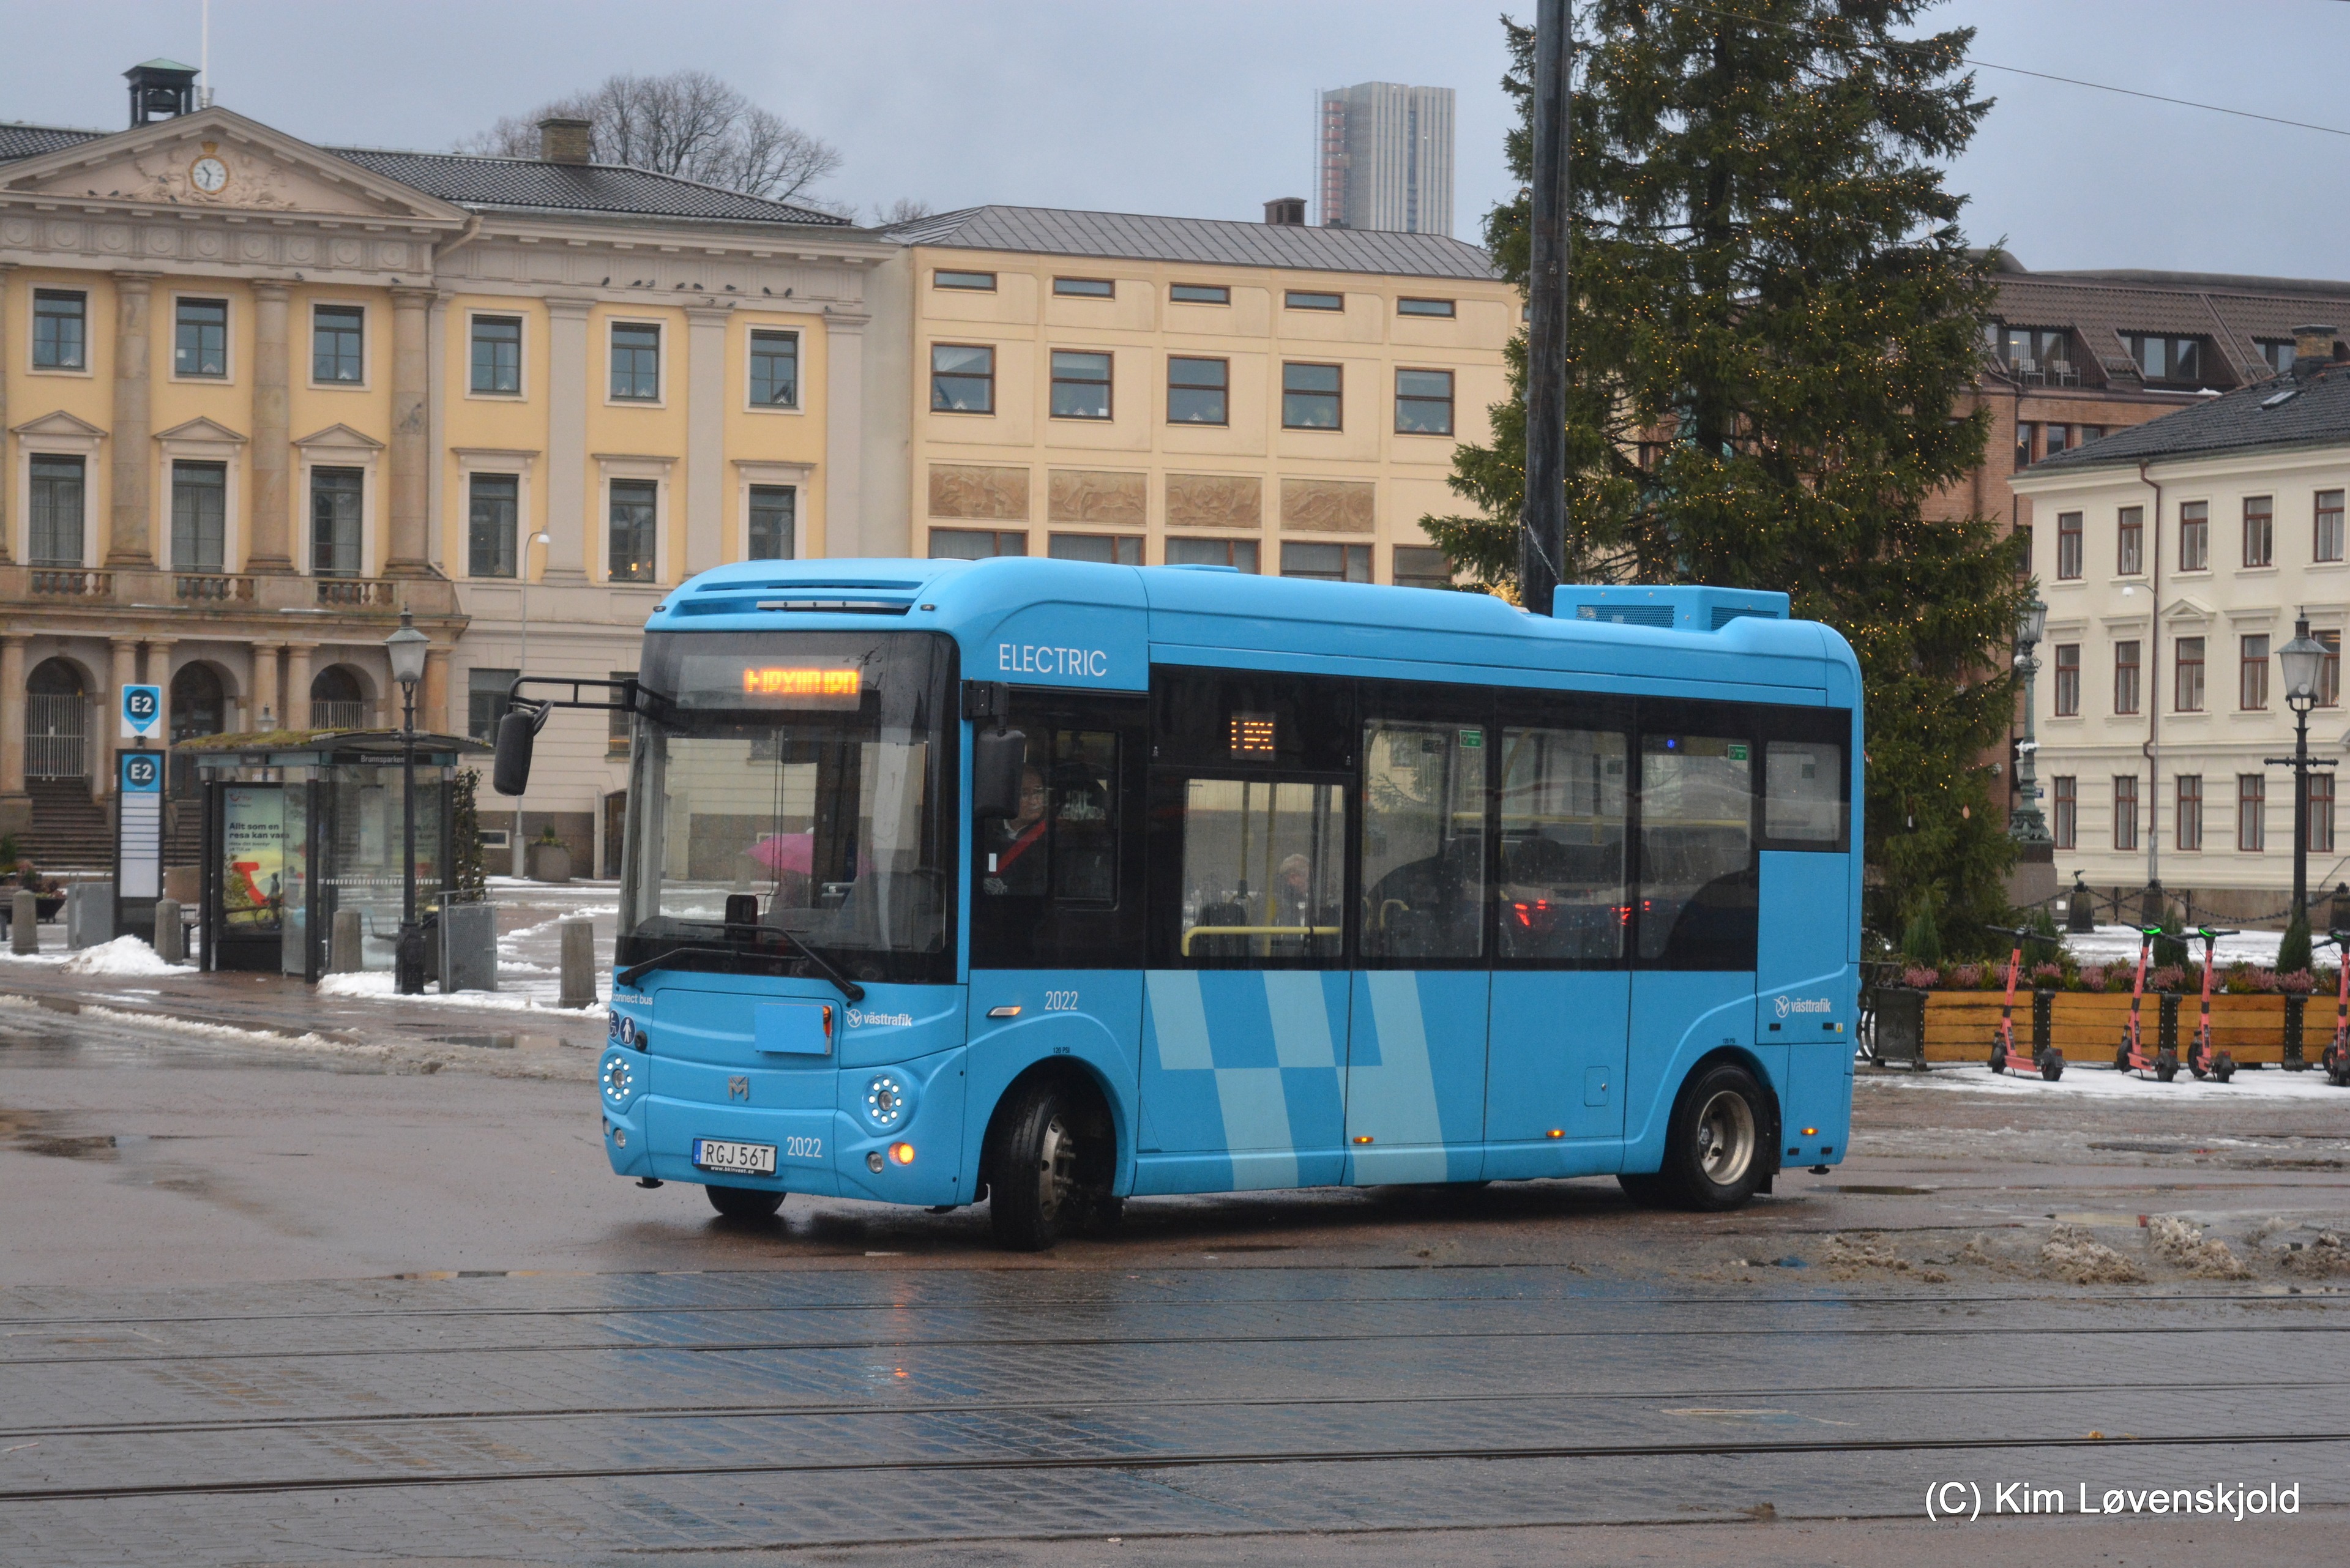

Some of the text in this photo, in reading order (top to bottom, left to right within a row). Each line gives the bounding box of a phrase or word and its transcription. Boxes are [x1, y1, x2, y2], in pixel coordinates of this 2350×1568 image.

[999, 644, 1107, 677] ELECTRIC
[131, 696, 152, 712] E2
[360, 755, 405, 764] Brunnsparken
[131, 764, 152, 779] E2
[613, 993, 653, 1005] connect bus
[1045, 991, 1078, 1010] 2022
[1791, 998, 1831, 1013] västtrafik
[864, 1012, 912, 1026] västtrafik
[787, 1137, 822, 1158] 2022
[706, 1144, 734, 1164] RGJ
[739, 1146, 769, 1168] 56T
[711, 1165, 755, 1174] www.bkinvest.se
